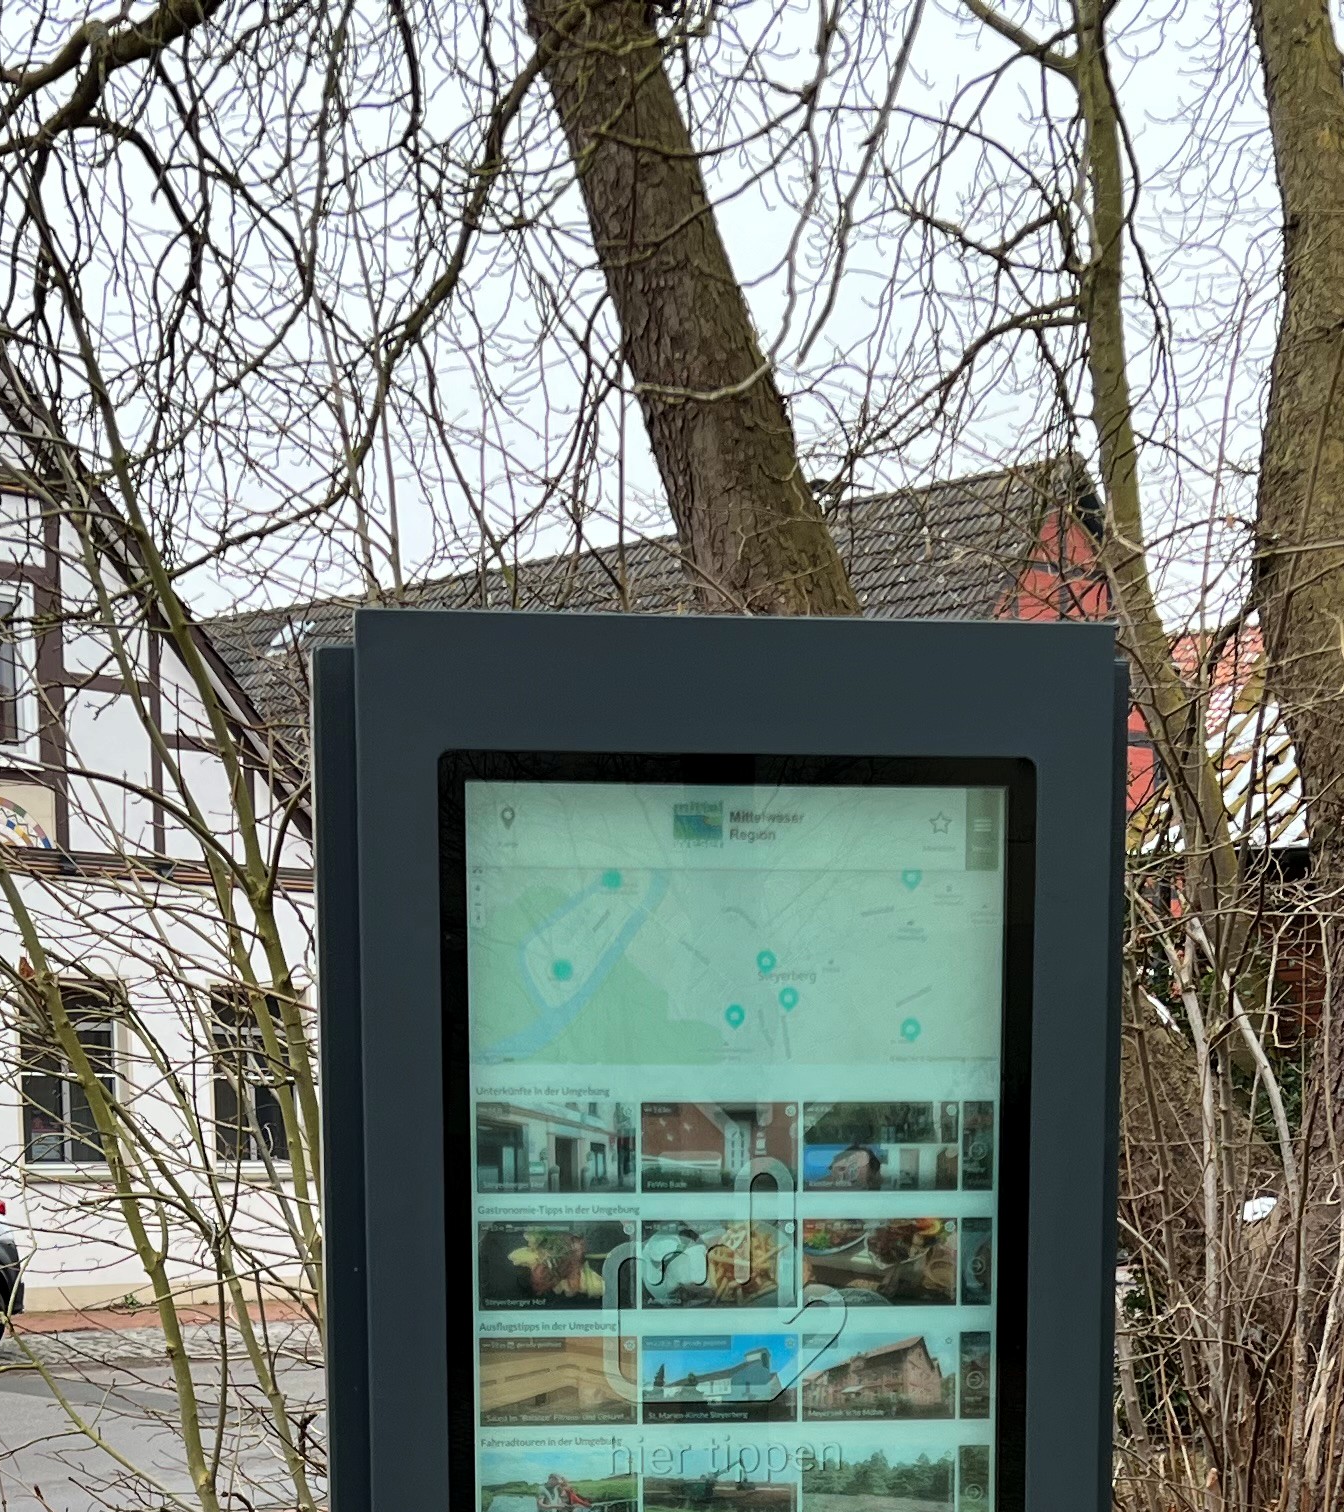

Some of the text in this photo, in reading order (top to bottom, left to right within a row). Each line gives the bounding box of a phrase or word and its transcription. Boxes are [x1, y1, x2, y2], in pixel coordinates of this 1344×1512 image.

[730, 810, 805, 824] Mittelweser
[730, 828, 776, 843] Region
[476, 1086, 611, 1099] Unterkünfte in der Umgebung
[478, 1204, 641, 1217] Gastronomie-Tipps in der Umgebung
[479, 1320, 617, 1334] Ausflugstipps in der Umgebung
[481, 1437, 546, 1448] Fahrradtouren
[547, 1437, 557, 1447] in
[558, 1437, 573, 1447] der
[611, 1434, 843, 1484] hier tippen
